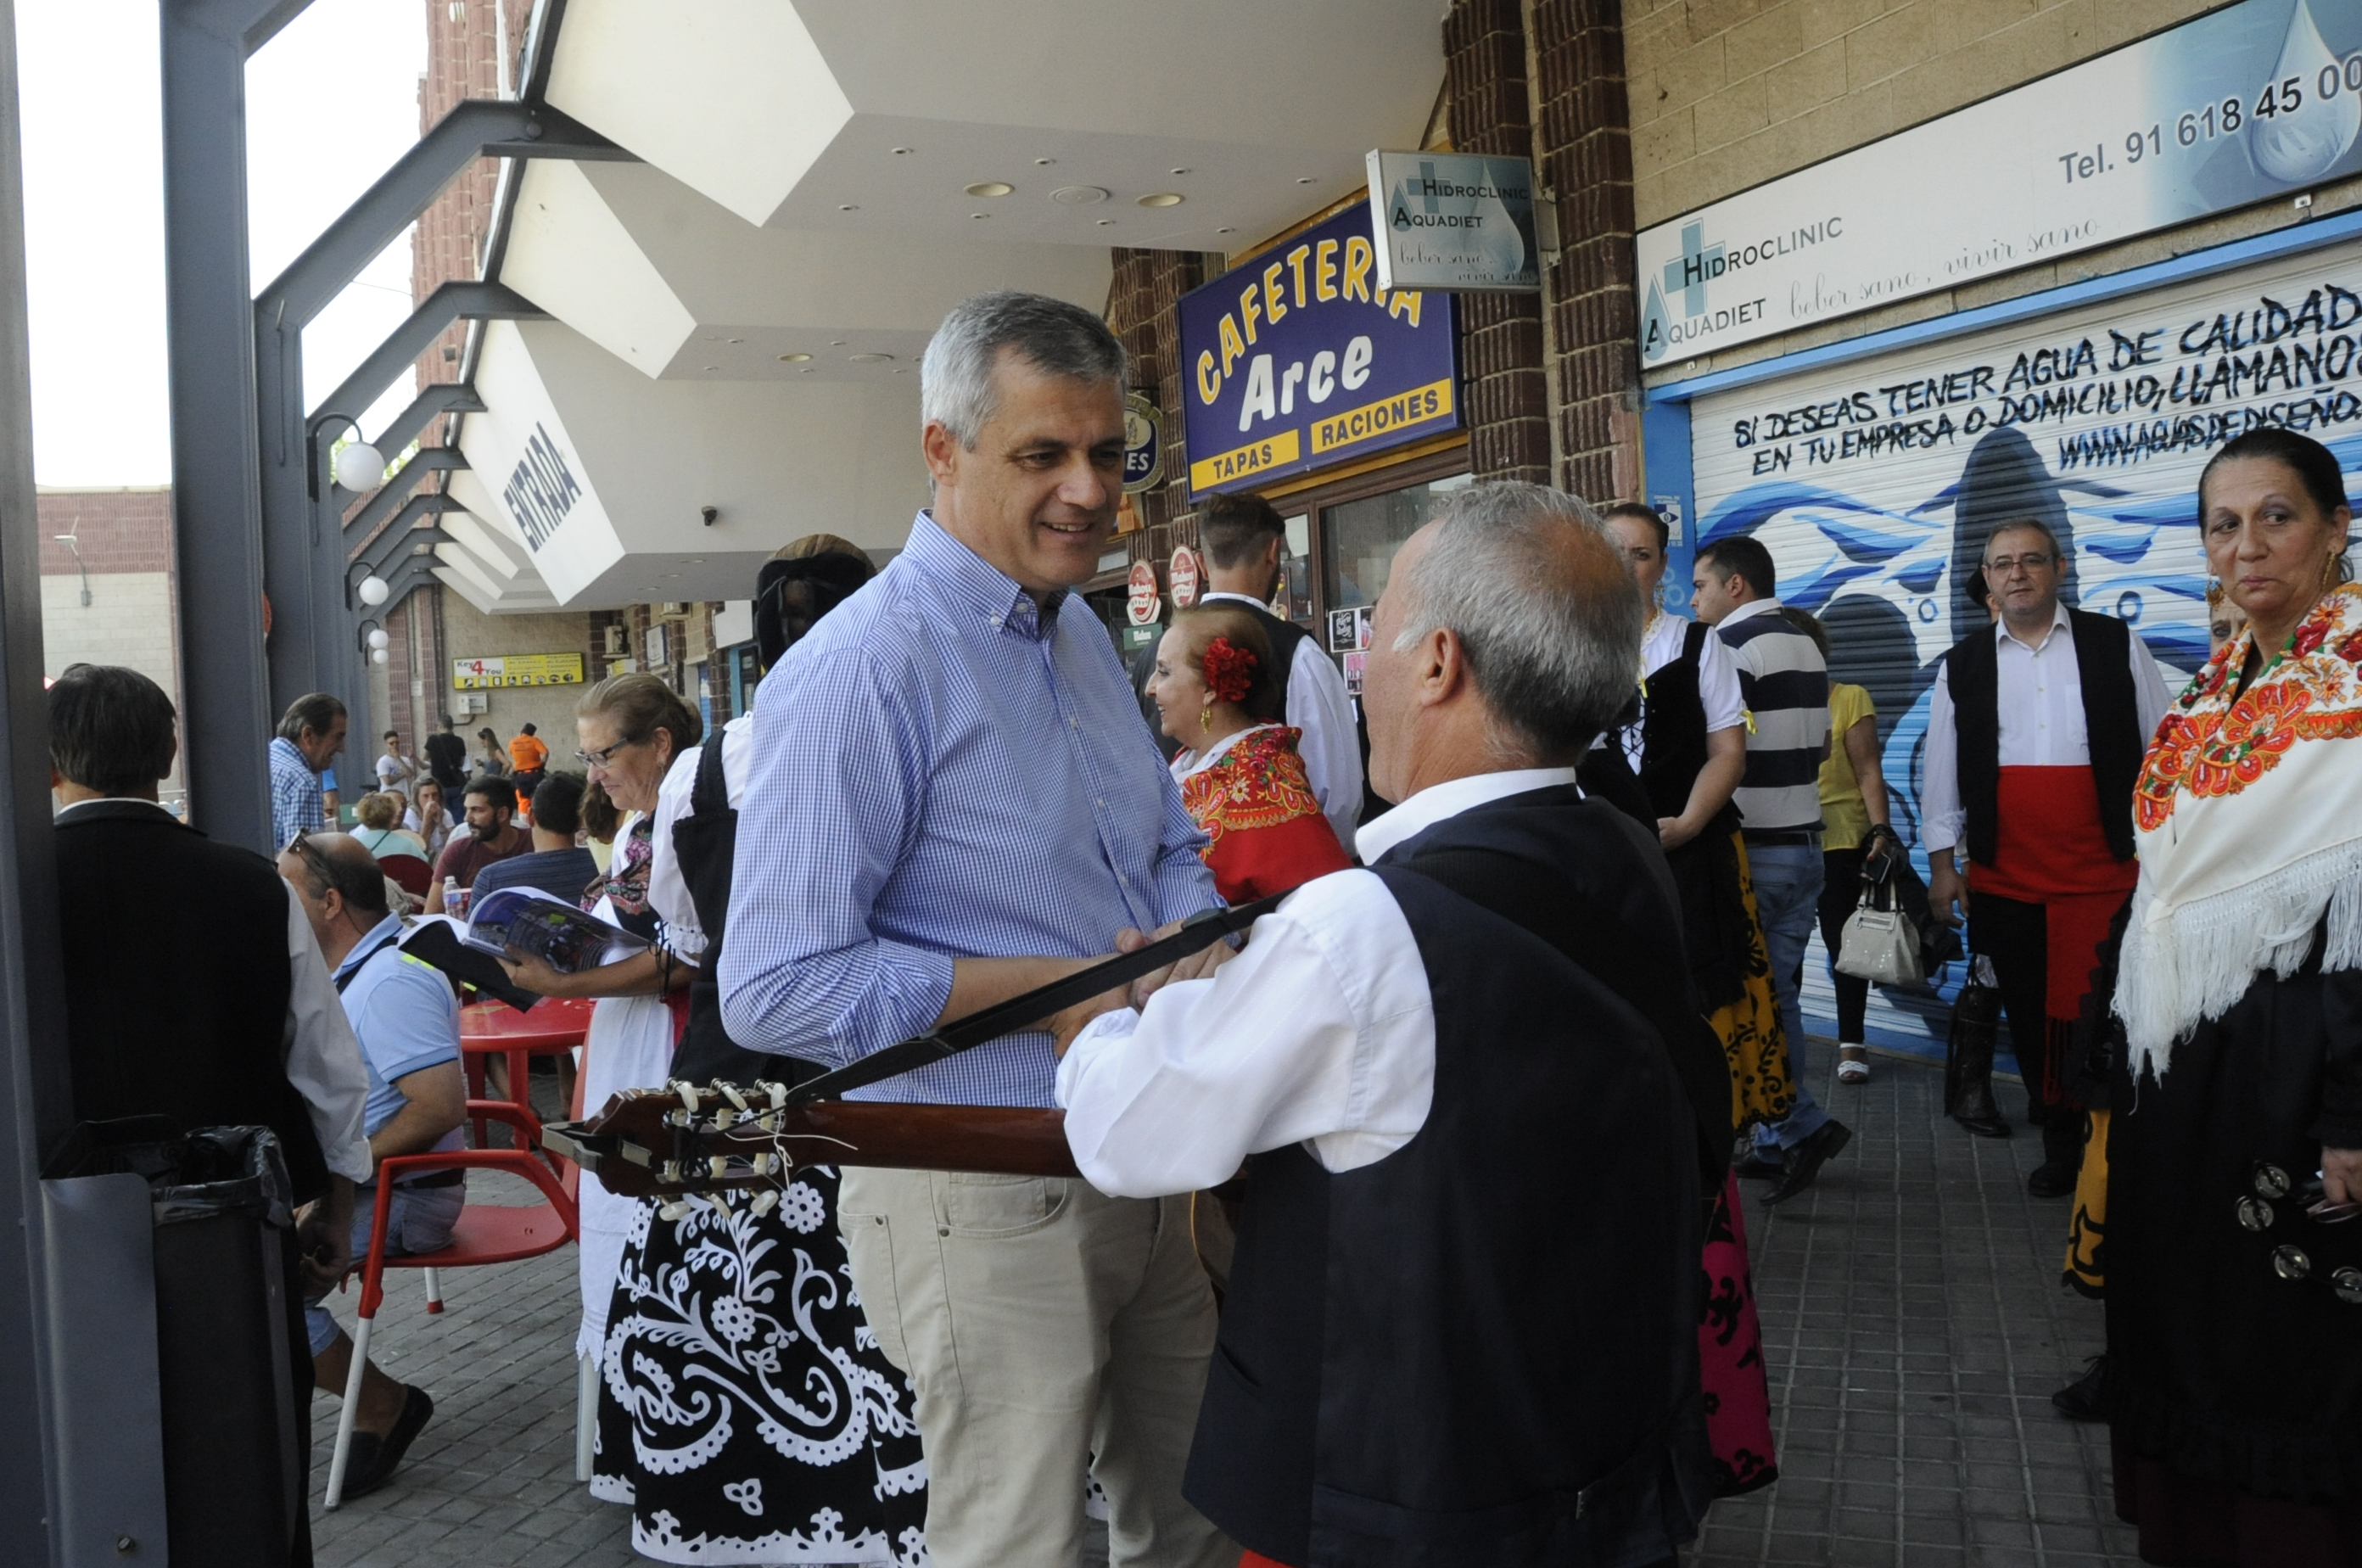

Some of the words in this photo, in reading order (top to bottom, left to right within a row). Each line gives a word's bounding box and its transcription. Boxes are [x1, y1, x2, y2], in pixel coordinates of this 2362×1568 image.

[2058, 143, 2113, 183] Tel.
[2125, 124, 2161, 164] 91
[2177, 98, 2242, 146] 618
[2255, 76, 2302, 120] 45
[2317, 55, 2362, 100] 00
[1789, 273, 1852, 319] beber
[1944, 239, 2018, 275] vivir
[2027, 219, 2102, 253] sano
[1239, 336, 1372, 432] Arce
[1734, 415, 1758, 449] SI
[1763, 391, 1878, 442] DESEAS
[1879, 366, 1995, 417] TENER
[2002, 337, 2099, 394] AGUA
[2107, 328, 2166, 372] DE
[2179, 283, 2362, 356] CALIDAD
[1753, 443, 1792, 475] EN
[1800, 437, 1836, 466] TU
[1839, 412, 1957, 459] EMPRESA
[1963, 406, 1987, 435] O
[2168, 333, 2362, 406] LLAMANO
[503, 421, 582, 553] ENTRADA
[1213, 443, 1272, 479] TAPAS
[1321, 389, 1439, 446] RACIONES
[472, 660, 484, 675] 4
